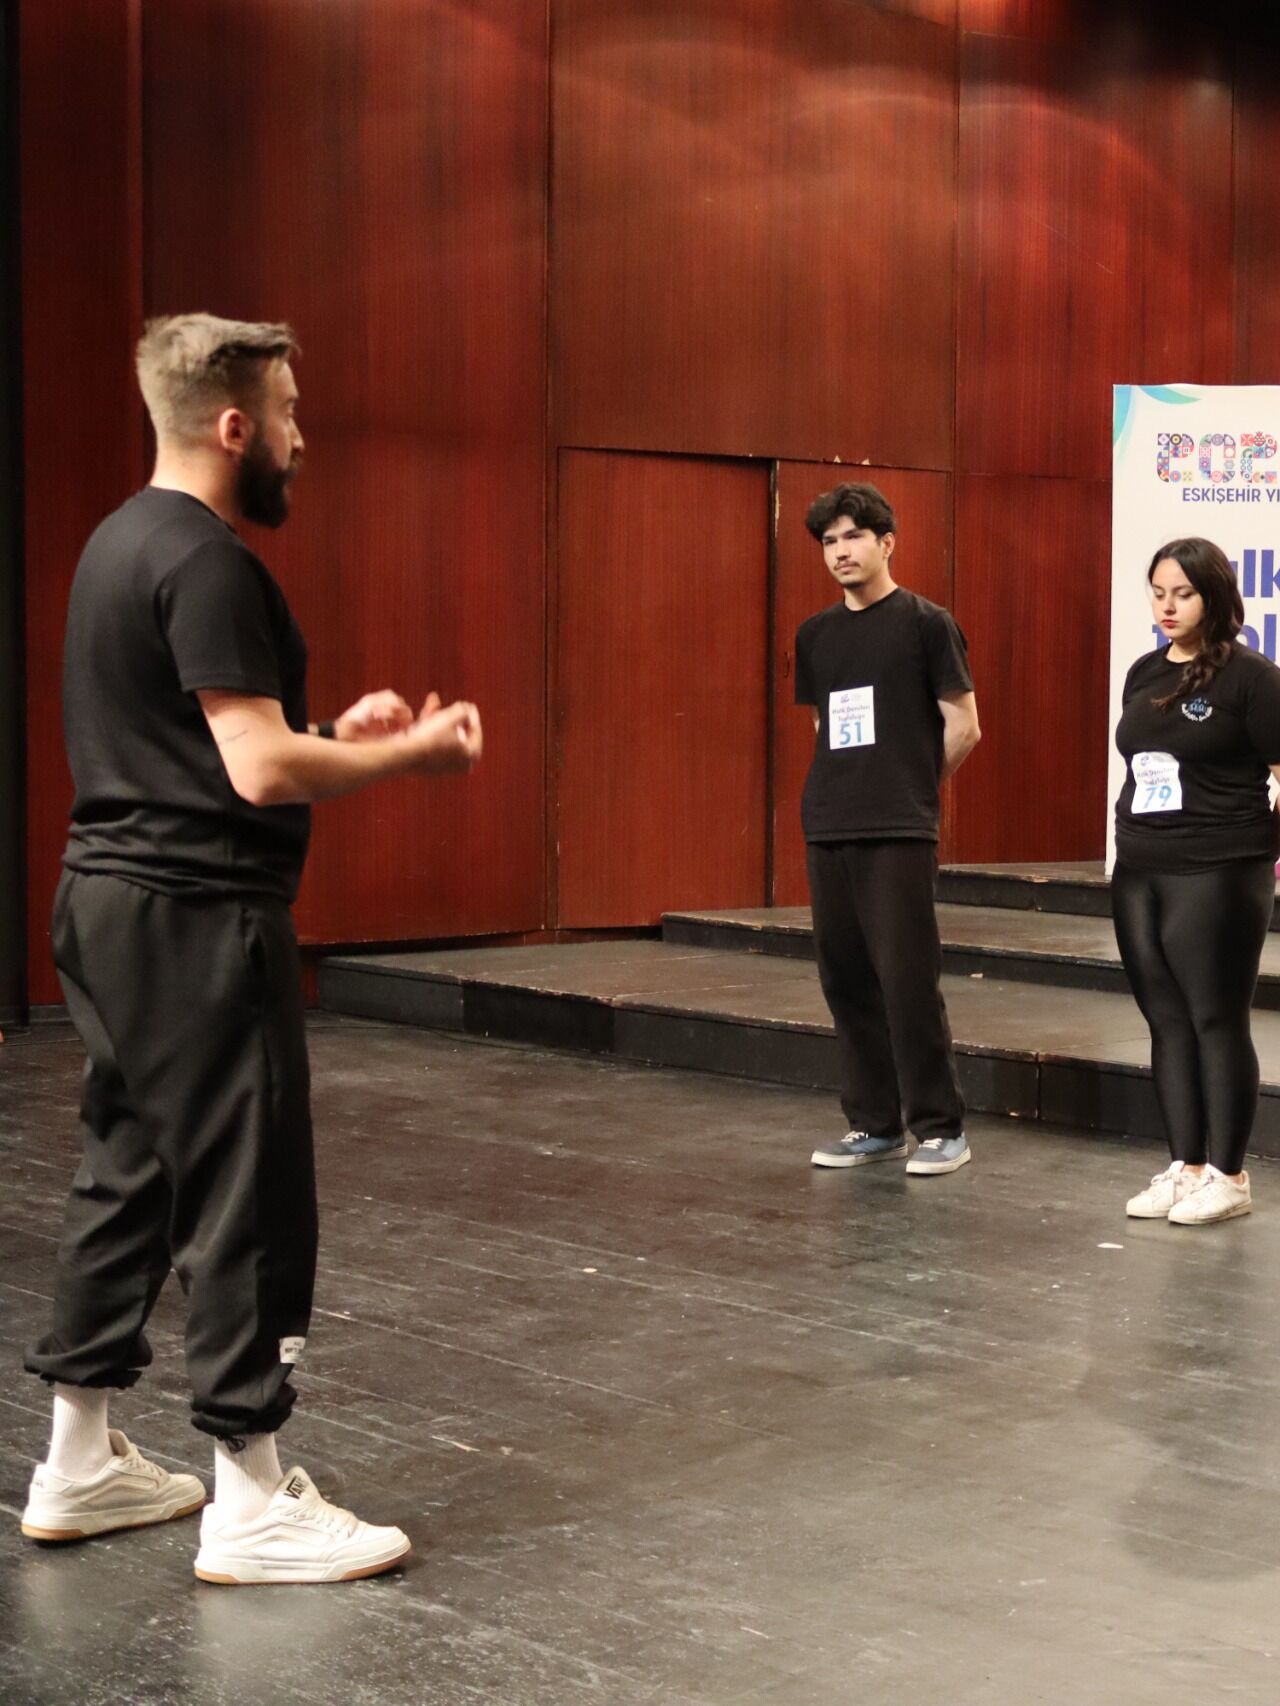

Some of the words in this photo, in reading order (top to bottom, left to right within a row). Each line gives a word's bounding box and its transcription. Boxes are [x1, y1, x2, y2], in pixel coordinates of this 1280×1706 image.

[1182, 485, 1261, 504] ESKİŞEHİR
[839, 721, 862, 746] 51
[1144, 785, 1172, 809] 79
